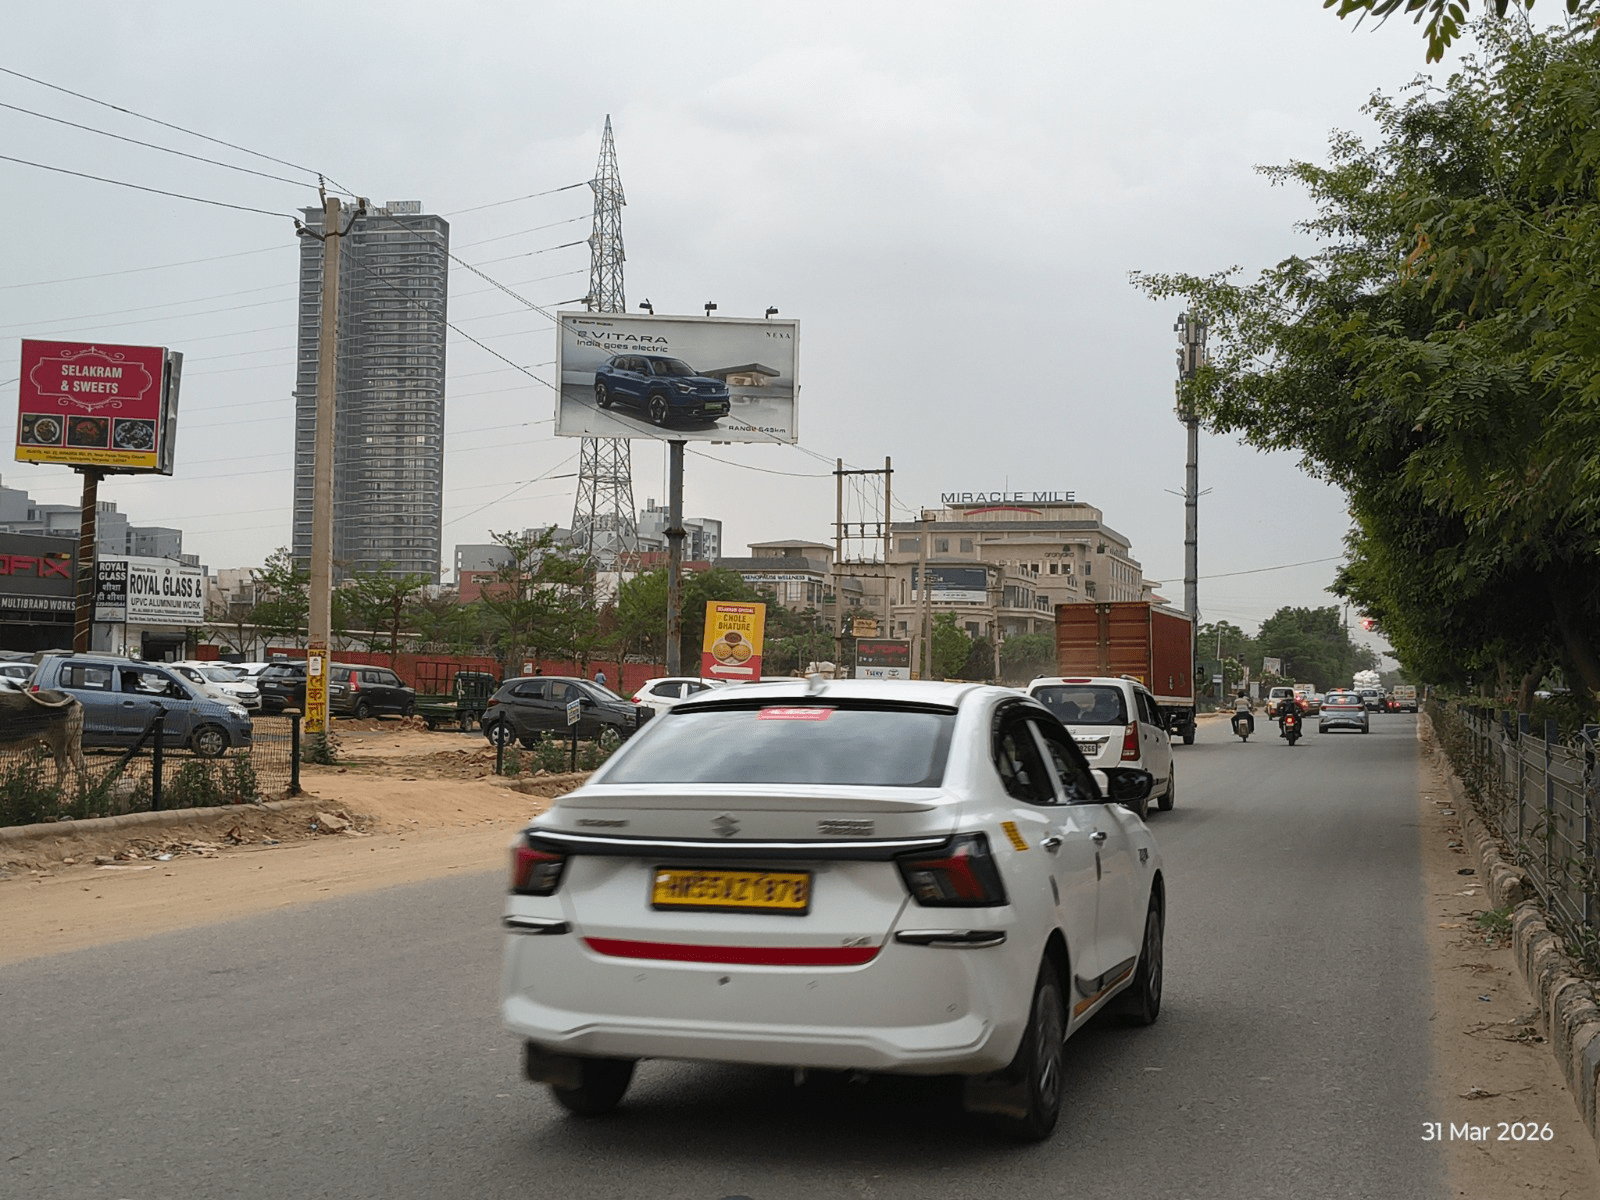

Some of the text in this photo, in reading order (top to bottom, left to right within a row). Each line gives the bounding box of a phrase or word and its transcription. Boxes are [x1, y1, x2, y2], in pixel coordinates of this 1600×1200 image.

[592, 331, 668, 344] VITARA
[577, 340, 669, 352] India goes electric
[61, 364, 122, 378] SELAKRAM
[61, 380, 118, 394] & SWEETS
[941, 491, 1075, 503] MIRACLE MILE
[99, 562, 126, 571] ROYAL
[98, 572, 126, 581] GLASS
[130, 573, 202, 598] ROYAL GLASS &
[1, 597, 76, 611] MULTIBRAND WORKS
[130, 597, 147, 606] UPVC
[183, 600, 201, 609] WORK
[723, 614, 747, 623] CHOLE
[718, 622, 751, 631] BHATURE
